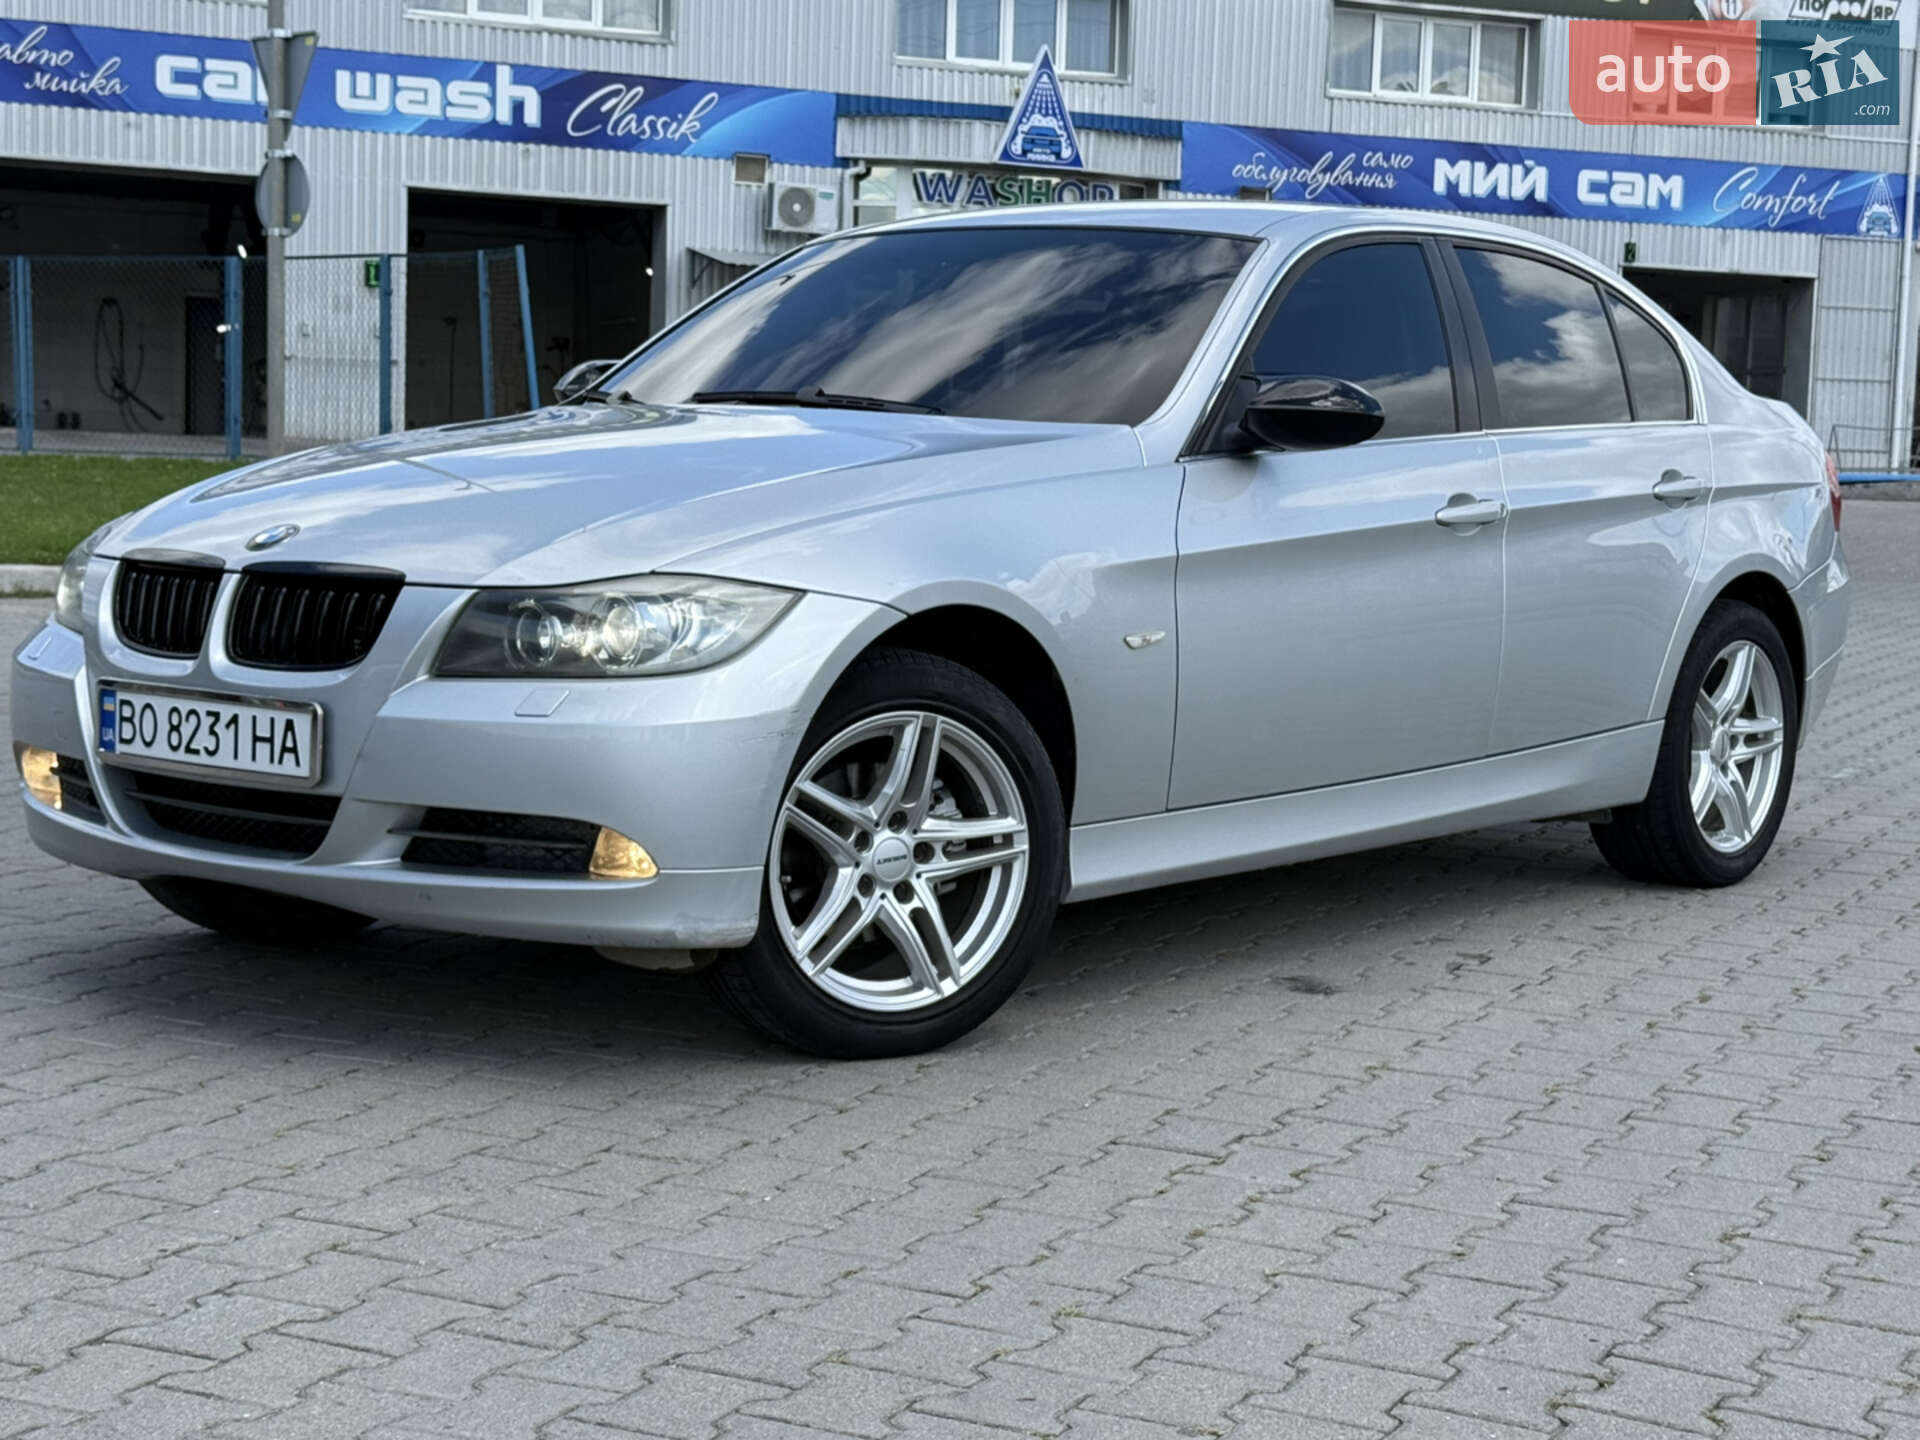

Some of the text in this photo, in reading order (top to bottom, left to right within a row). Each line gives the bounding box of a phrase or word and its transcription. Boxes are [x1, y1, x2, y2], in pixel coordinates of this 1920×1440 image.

[24, 56, 129, 97] мийка
[335, 64, 541, 128] wash
[566, 83, 719, 143] Classik
[1231, 151, 1398, 200] обслуговування
[1362, 151, 1414, 169] само
[1713, 166, 1841, 229] Comfort
[118, 699, 301, 768] BO 8231 HA
